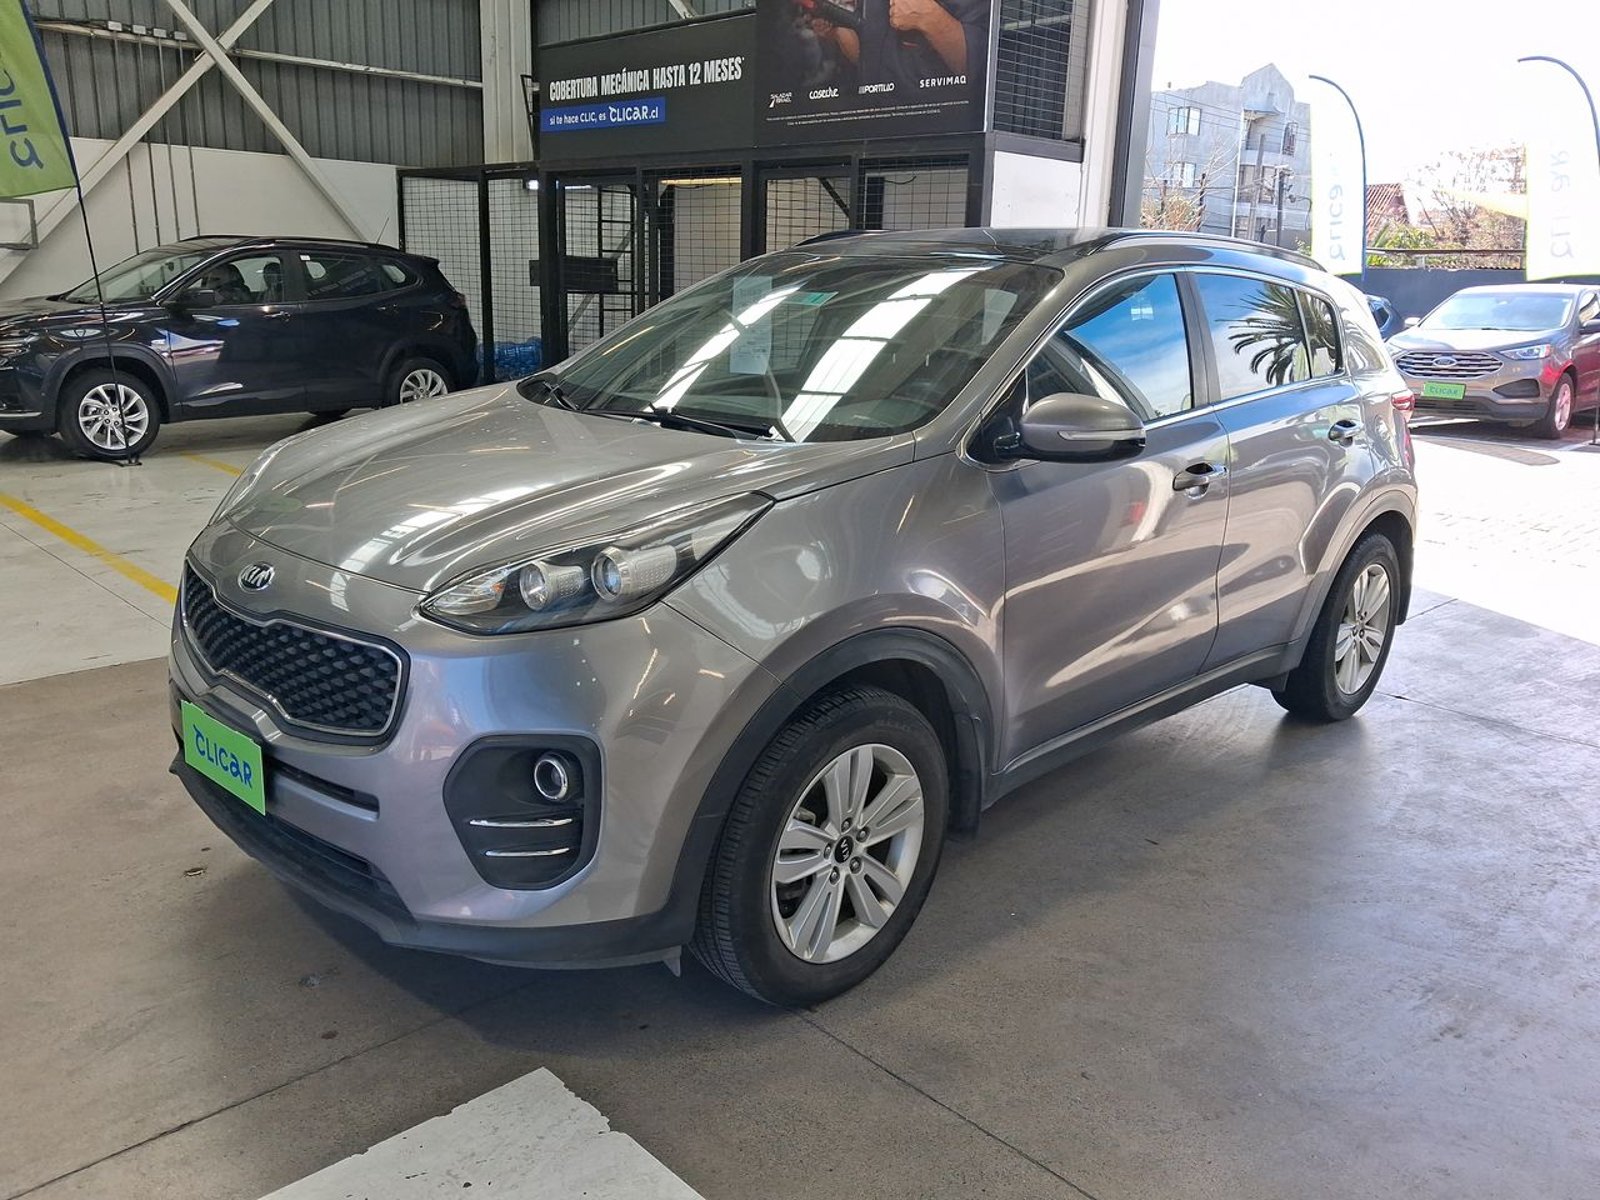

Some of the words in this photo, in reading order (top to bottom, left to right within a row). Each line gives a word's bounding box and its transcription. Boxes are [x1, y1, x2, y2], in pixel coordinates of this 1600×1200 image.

[549, 76, 598, 101] COBERTURA
[601, 67, 650, 96] MECÁNICA
[653, 64, 686, 90] HASTA
[688, 62, 701, 86] 12
[919, 75, 967, 90] SERVIMAQ
[563, 115, 579, 124] hace
[580, 112, 597, 124] CLIC,
[599, 113, 606, 121] es
